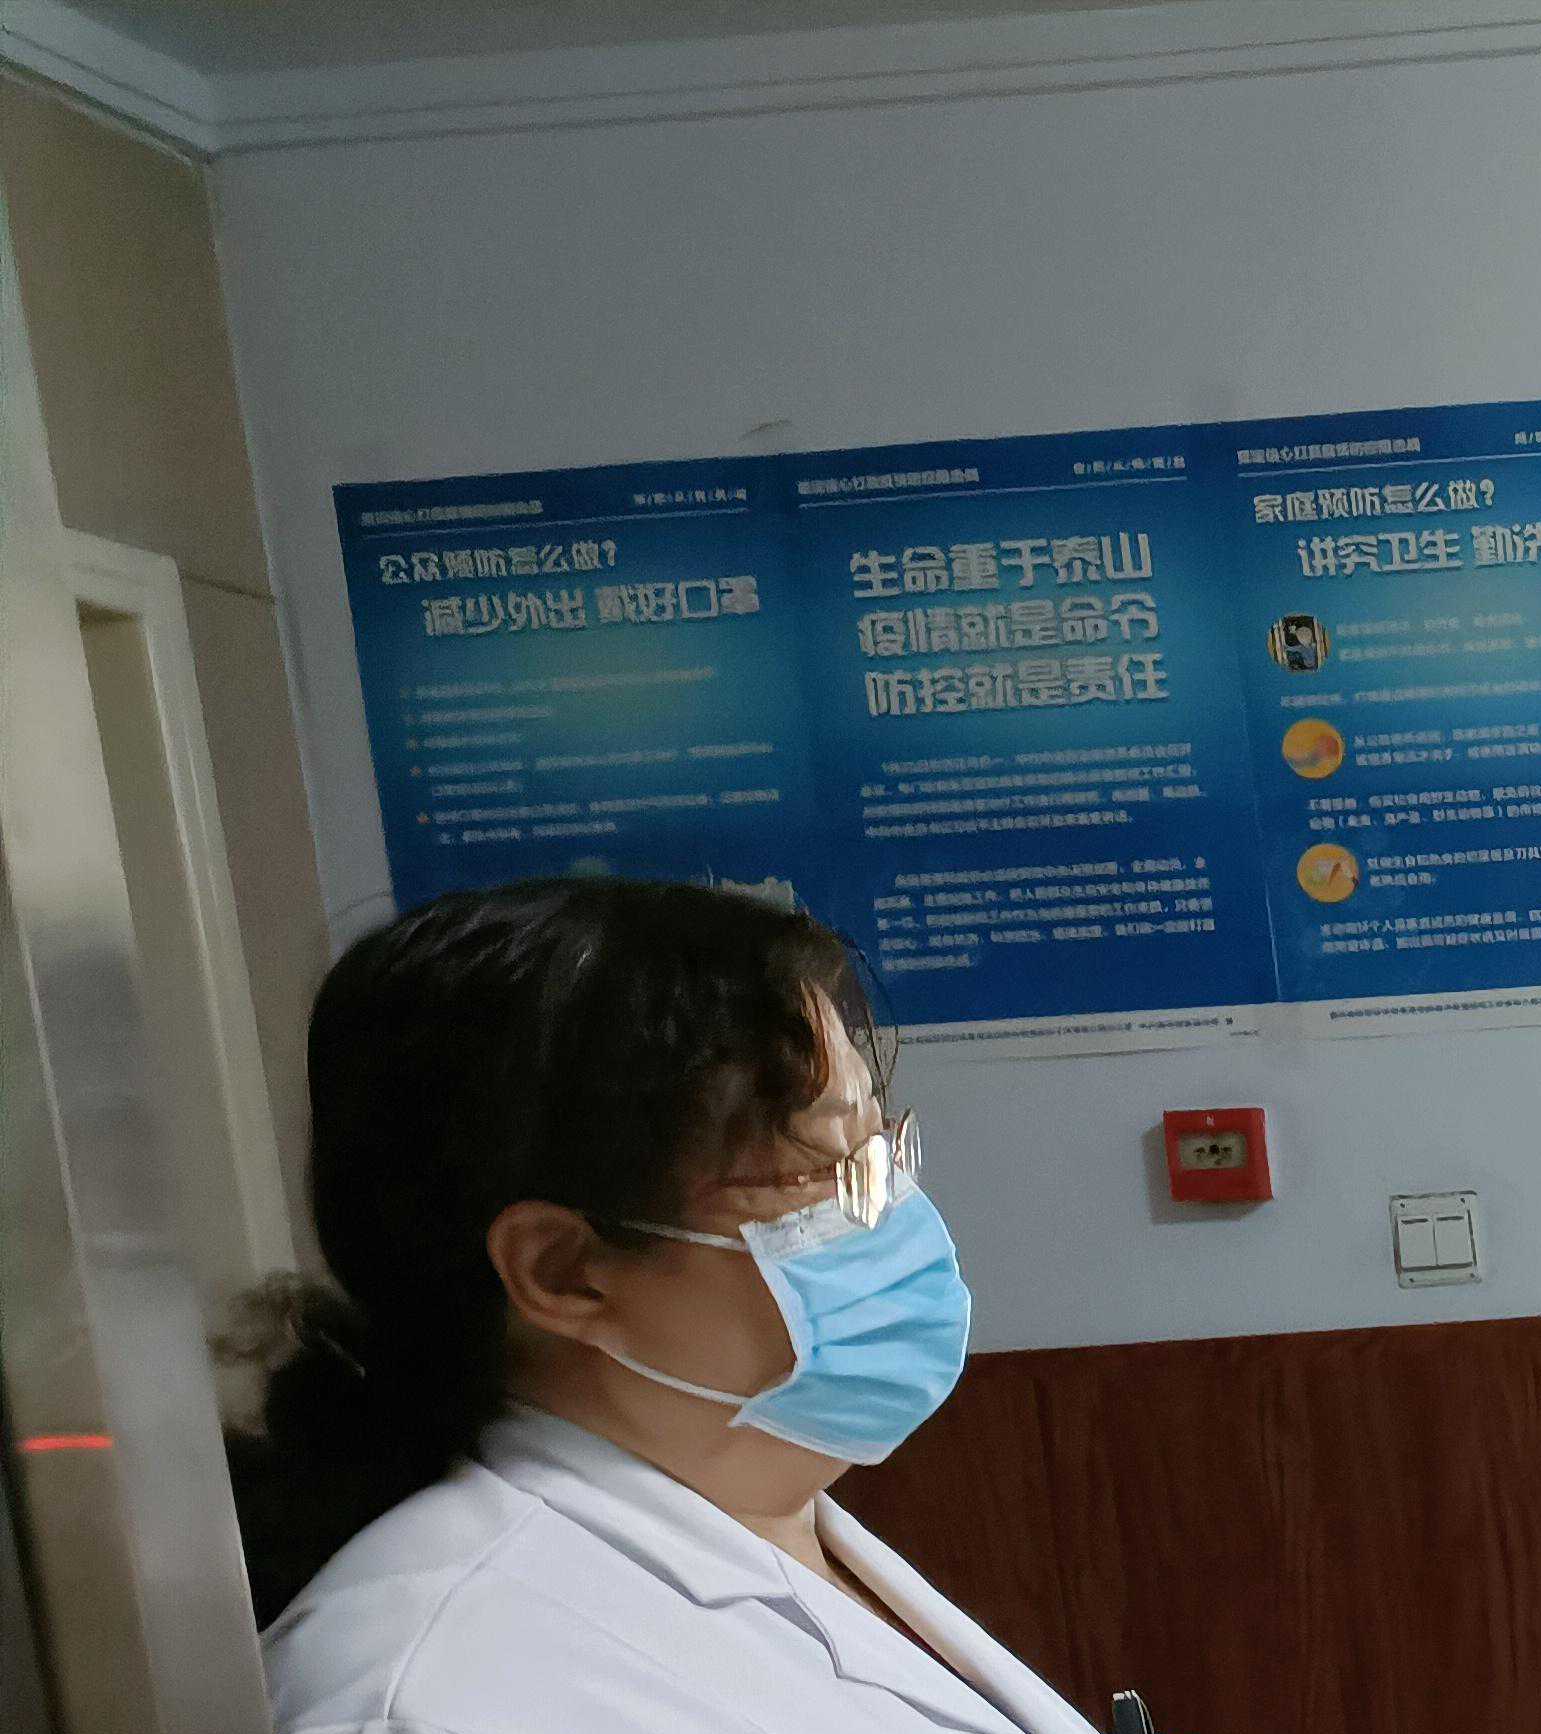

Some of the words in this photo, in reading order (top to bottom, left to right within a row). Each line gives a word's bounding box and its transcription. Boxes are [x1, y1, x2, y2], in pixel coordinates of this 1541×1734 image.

[850, 530, 1153, 598] 生命重于泰山
[1298, 527, 1464, 577] 讲究卫生
[421, 587, 587, 636] 减少外出
[856, 591, 1161, 658] 疫情就是命令
[864, 652, 1172, 717] 防控就是责任
